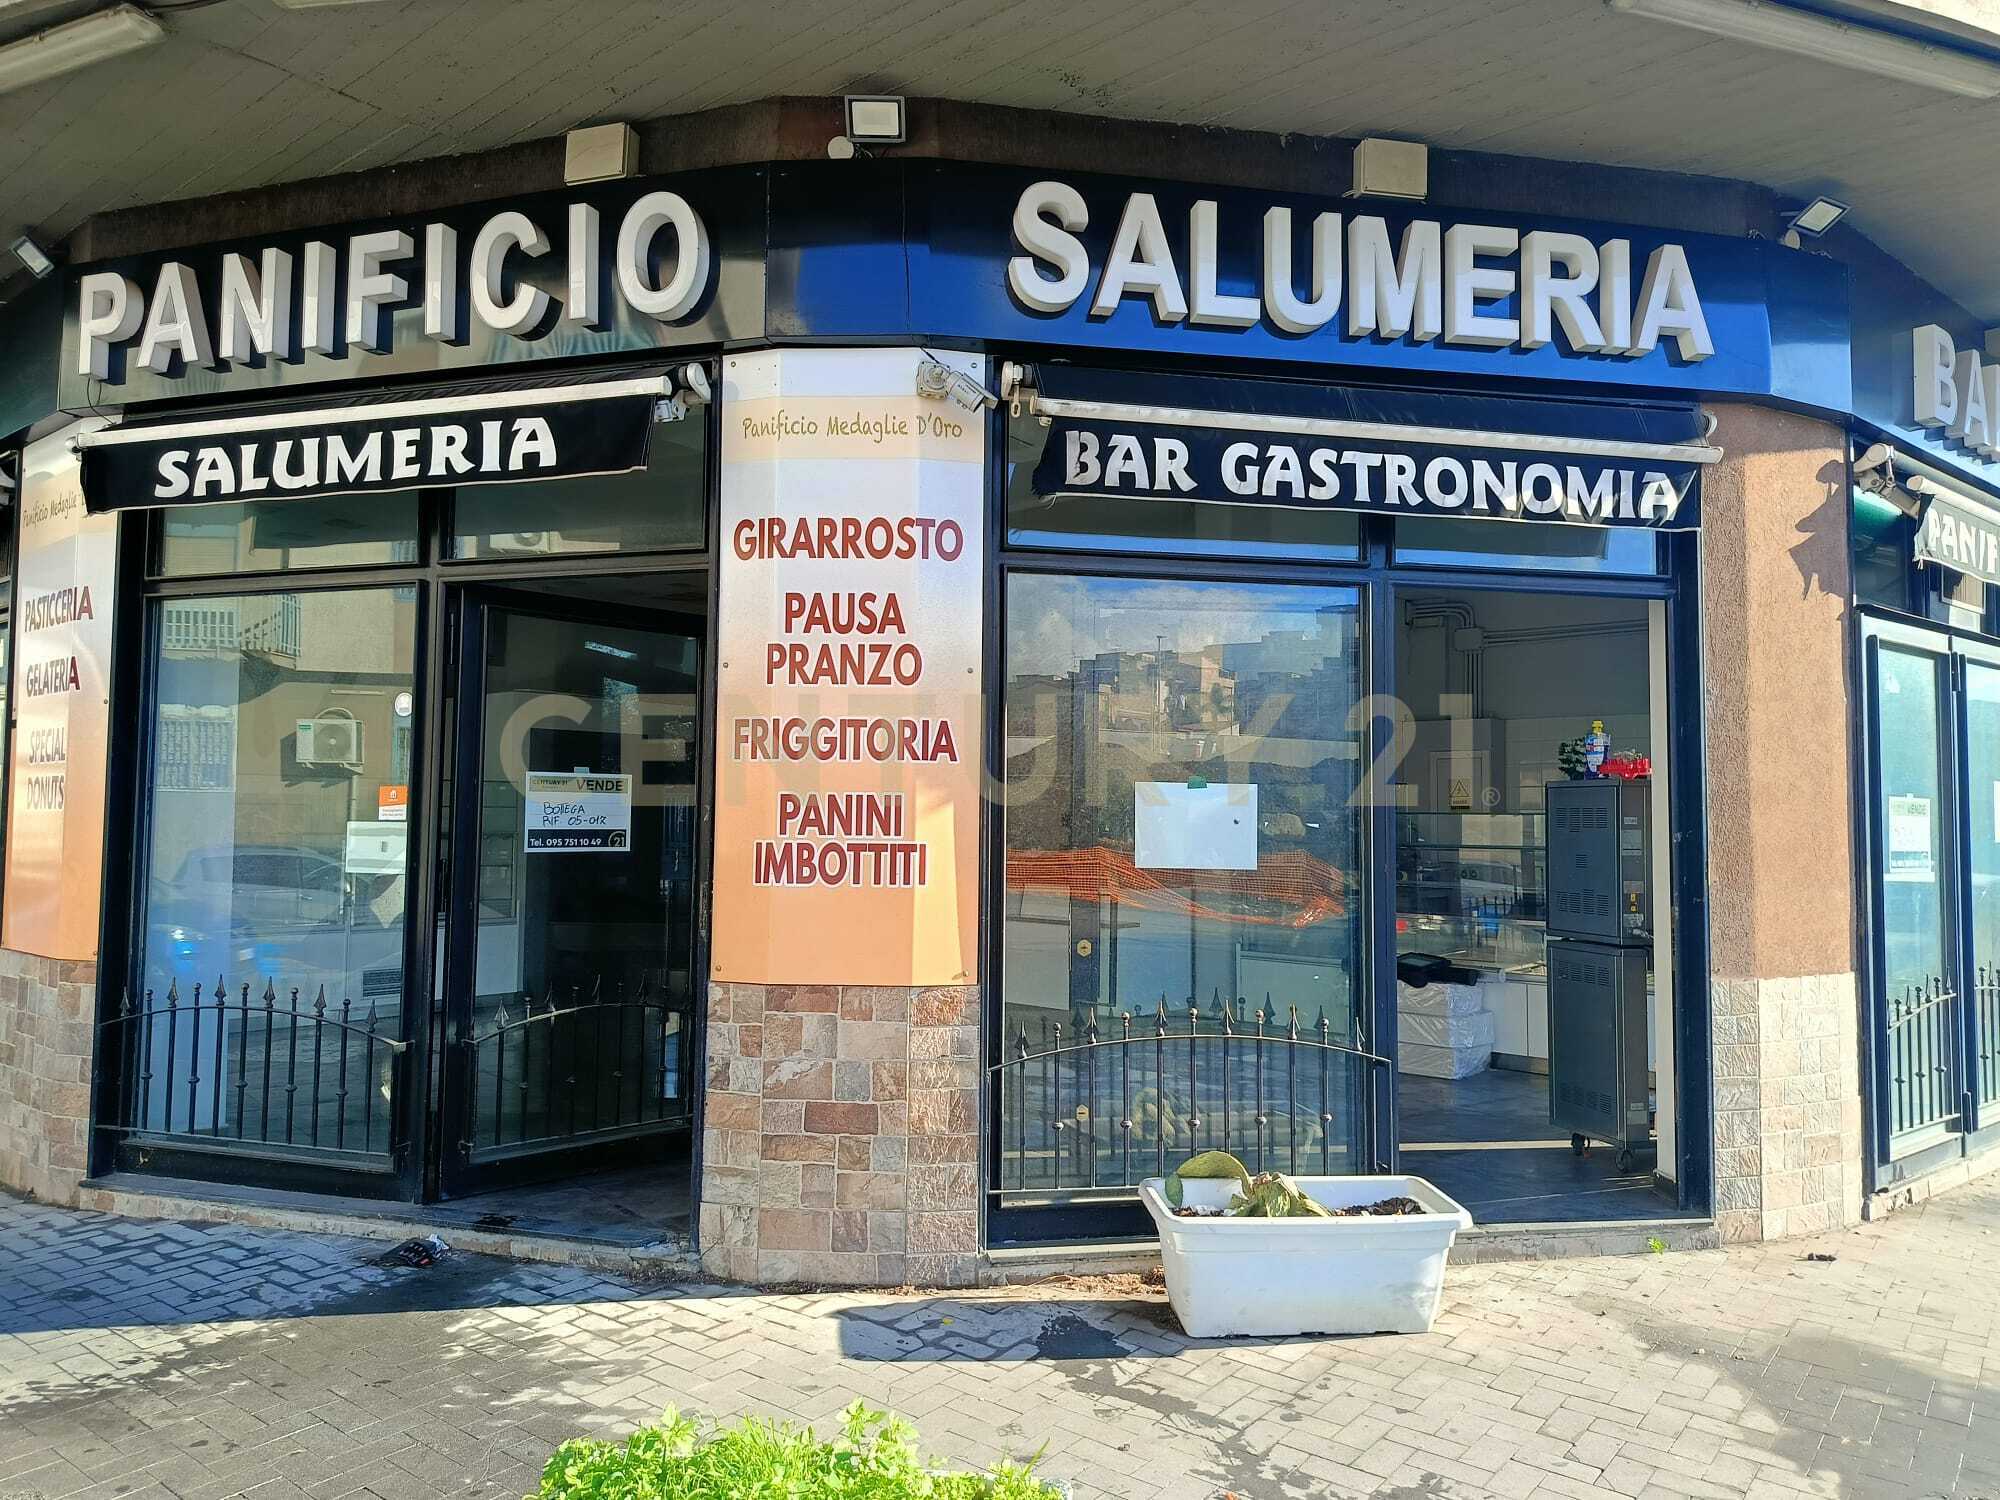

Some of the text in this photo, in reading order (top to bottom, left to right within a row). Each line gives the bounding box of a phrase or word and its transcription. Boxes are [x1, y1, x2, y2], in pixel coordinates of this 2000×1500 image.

[78, 191, 711, 380] PANIFICIO
[1007, 181, 1716, 362] SALUMERIA
[742, 410, 963, 443] Panificio Medaglie D'Oro
[154, 417, 557, 498] SALUMERIA
[1065, 430, 1697, 522] BAR GASTRONOMIA
[23, 500, 48, 528] Panificio
[50, 490, 77, 520] Medaglie
[733, 517, 964, 562] GIRARROSTO
[25, 585, 94, 633] PASTICCERIA
[785, 592, 906, 635] PAUSA
[27, 655, 80, 697] GELATERIA
[767, 643, 923, 686] PRANZO
[29, 727, 66, 763] SPECIAL
[734, 717, 958, 762] FRIGGITORIA
[27, 775, 64, 810] DONUTS
[576, 779, 623, 791] VENDE
[779, 793, 902, 837] PANINI
[529, 838, 544, 847] Tel.
[546, 838, 563, 846] 095
[564, 838, 578, 846] 751
[579, 838, 589, 846] 10
[613, 837, 625, 848] 21
[755, 841, 926, 887] IMBOTTITI
